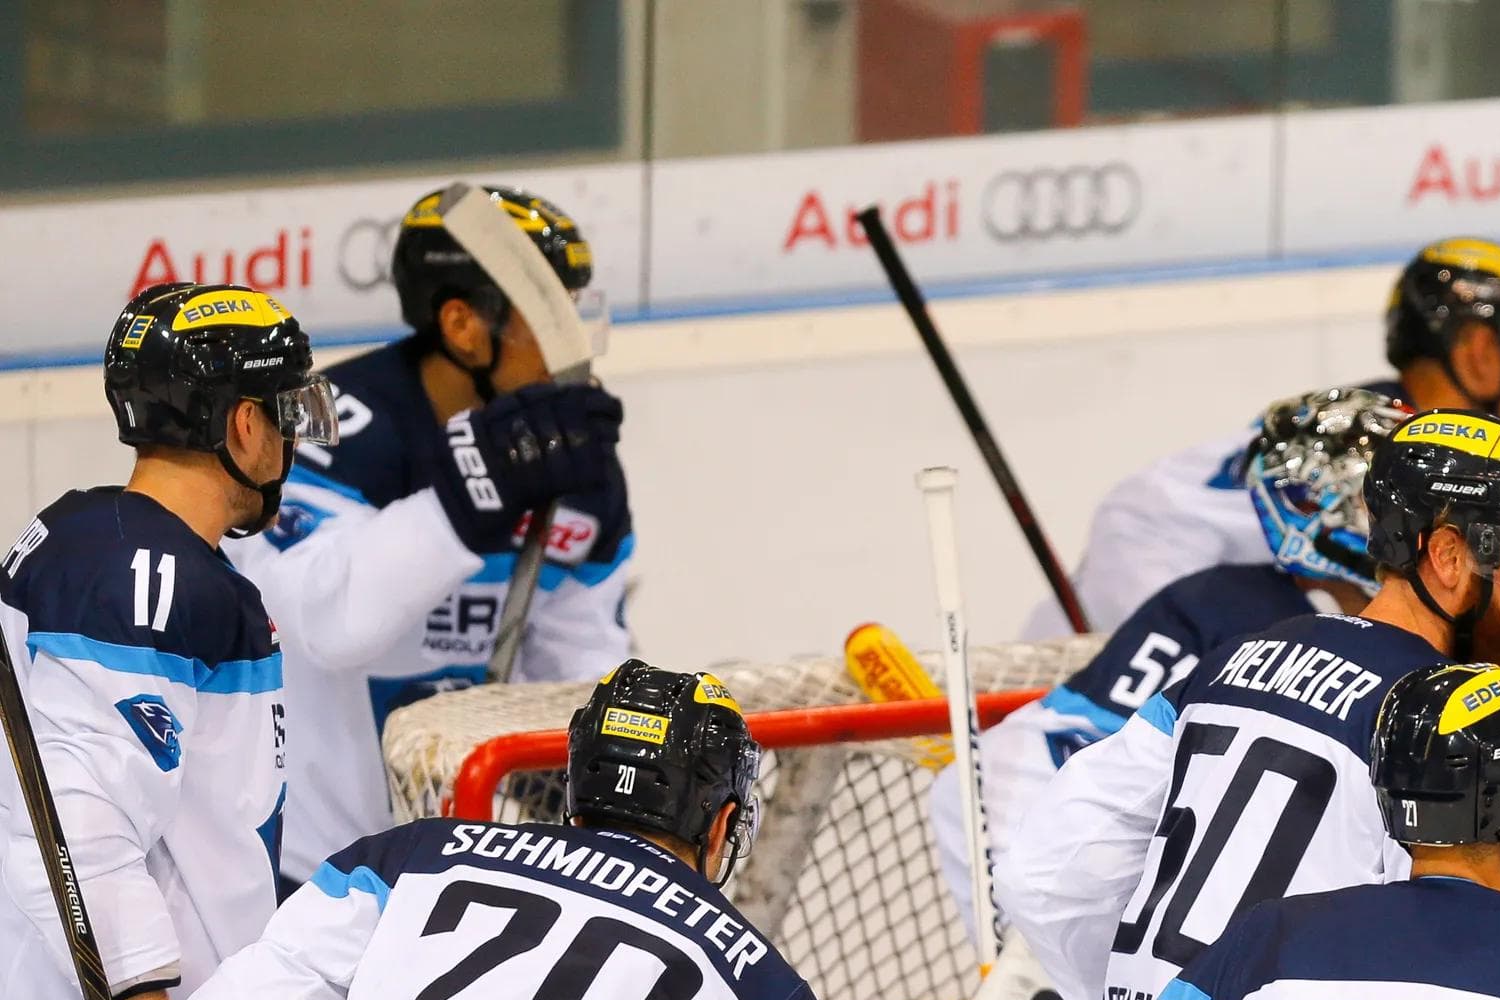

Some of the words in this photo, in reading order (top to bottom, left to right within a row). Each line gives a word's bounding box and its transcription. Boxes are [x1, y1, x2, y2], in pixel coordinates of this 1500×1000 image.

[781, 178, 962, 254] Audi
[129, 228, 313, 299] Audi
[183, 298, 255, 323] EDEKA
[243, 356, 284, 369] BAUER
[1406, 422, 1488, 442] EDEKA
[446, 410, 503, 511] BAU
[1429, 480, 1488, 496] BAUER
[130, 548, 176, 633] 11
[426, 594, 498, 634] ER
[607, 711, 664, 731] EDEKA
[614, 764, 637, 795] 20
[1402, 799, 1418, 827] 27
[1110, 721, 1339, 970] 50
[55, 843, 88, 935] SUPREME
[441, 822, 769, 982] SCHMIDPETER
